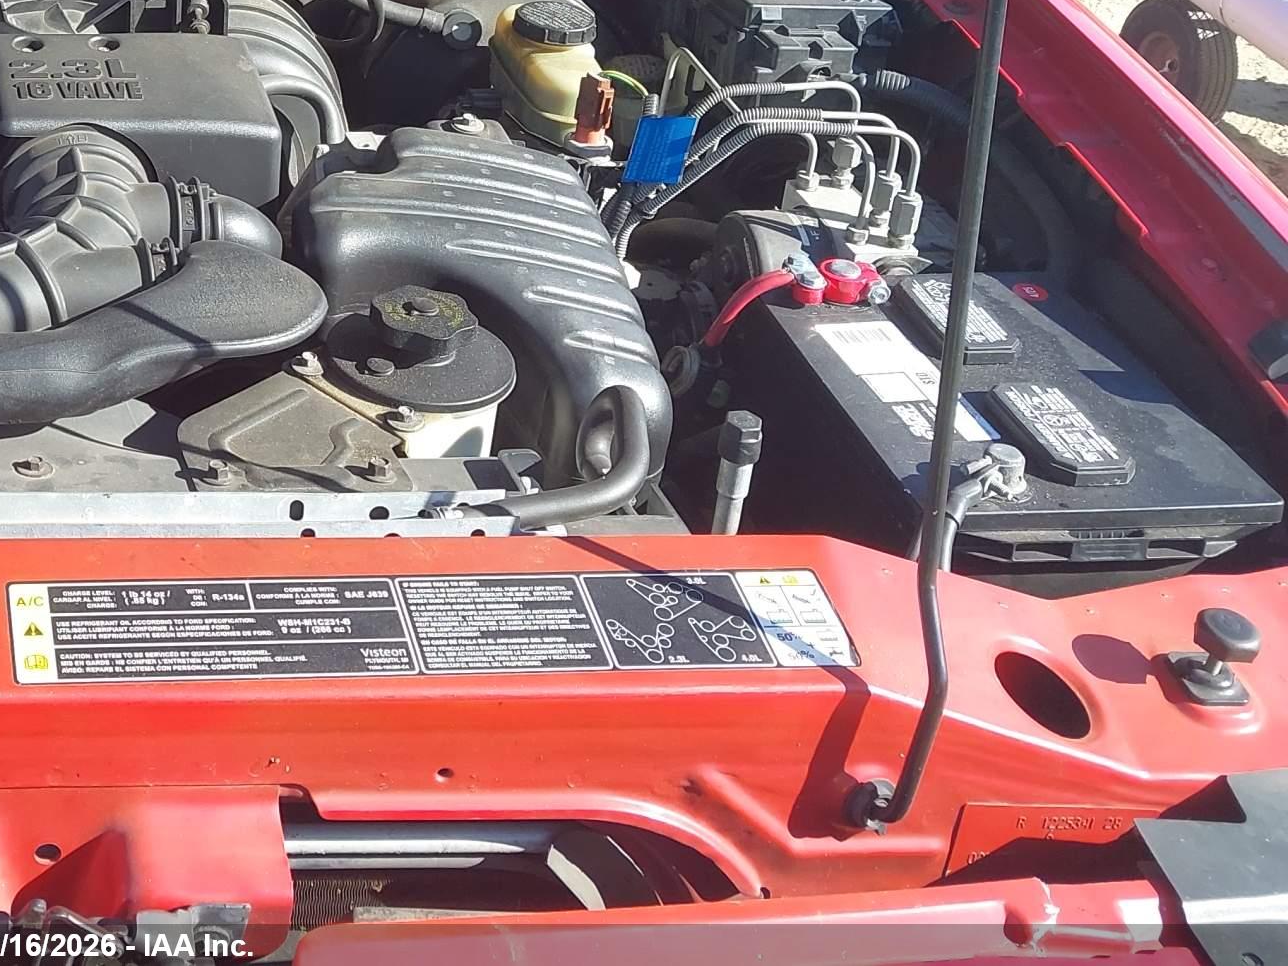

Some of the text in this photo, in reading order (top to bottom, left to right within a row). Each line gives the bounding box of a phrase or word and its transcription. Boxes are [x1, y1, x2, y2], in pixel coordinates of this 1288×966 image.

[12, 81, 144, 100] 16 VALVE
[212, 593, 245, 601] R-134a
[344, 590, 365, 599] SAE
[360, 648, 407, 658] Visteon
